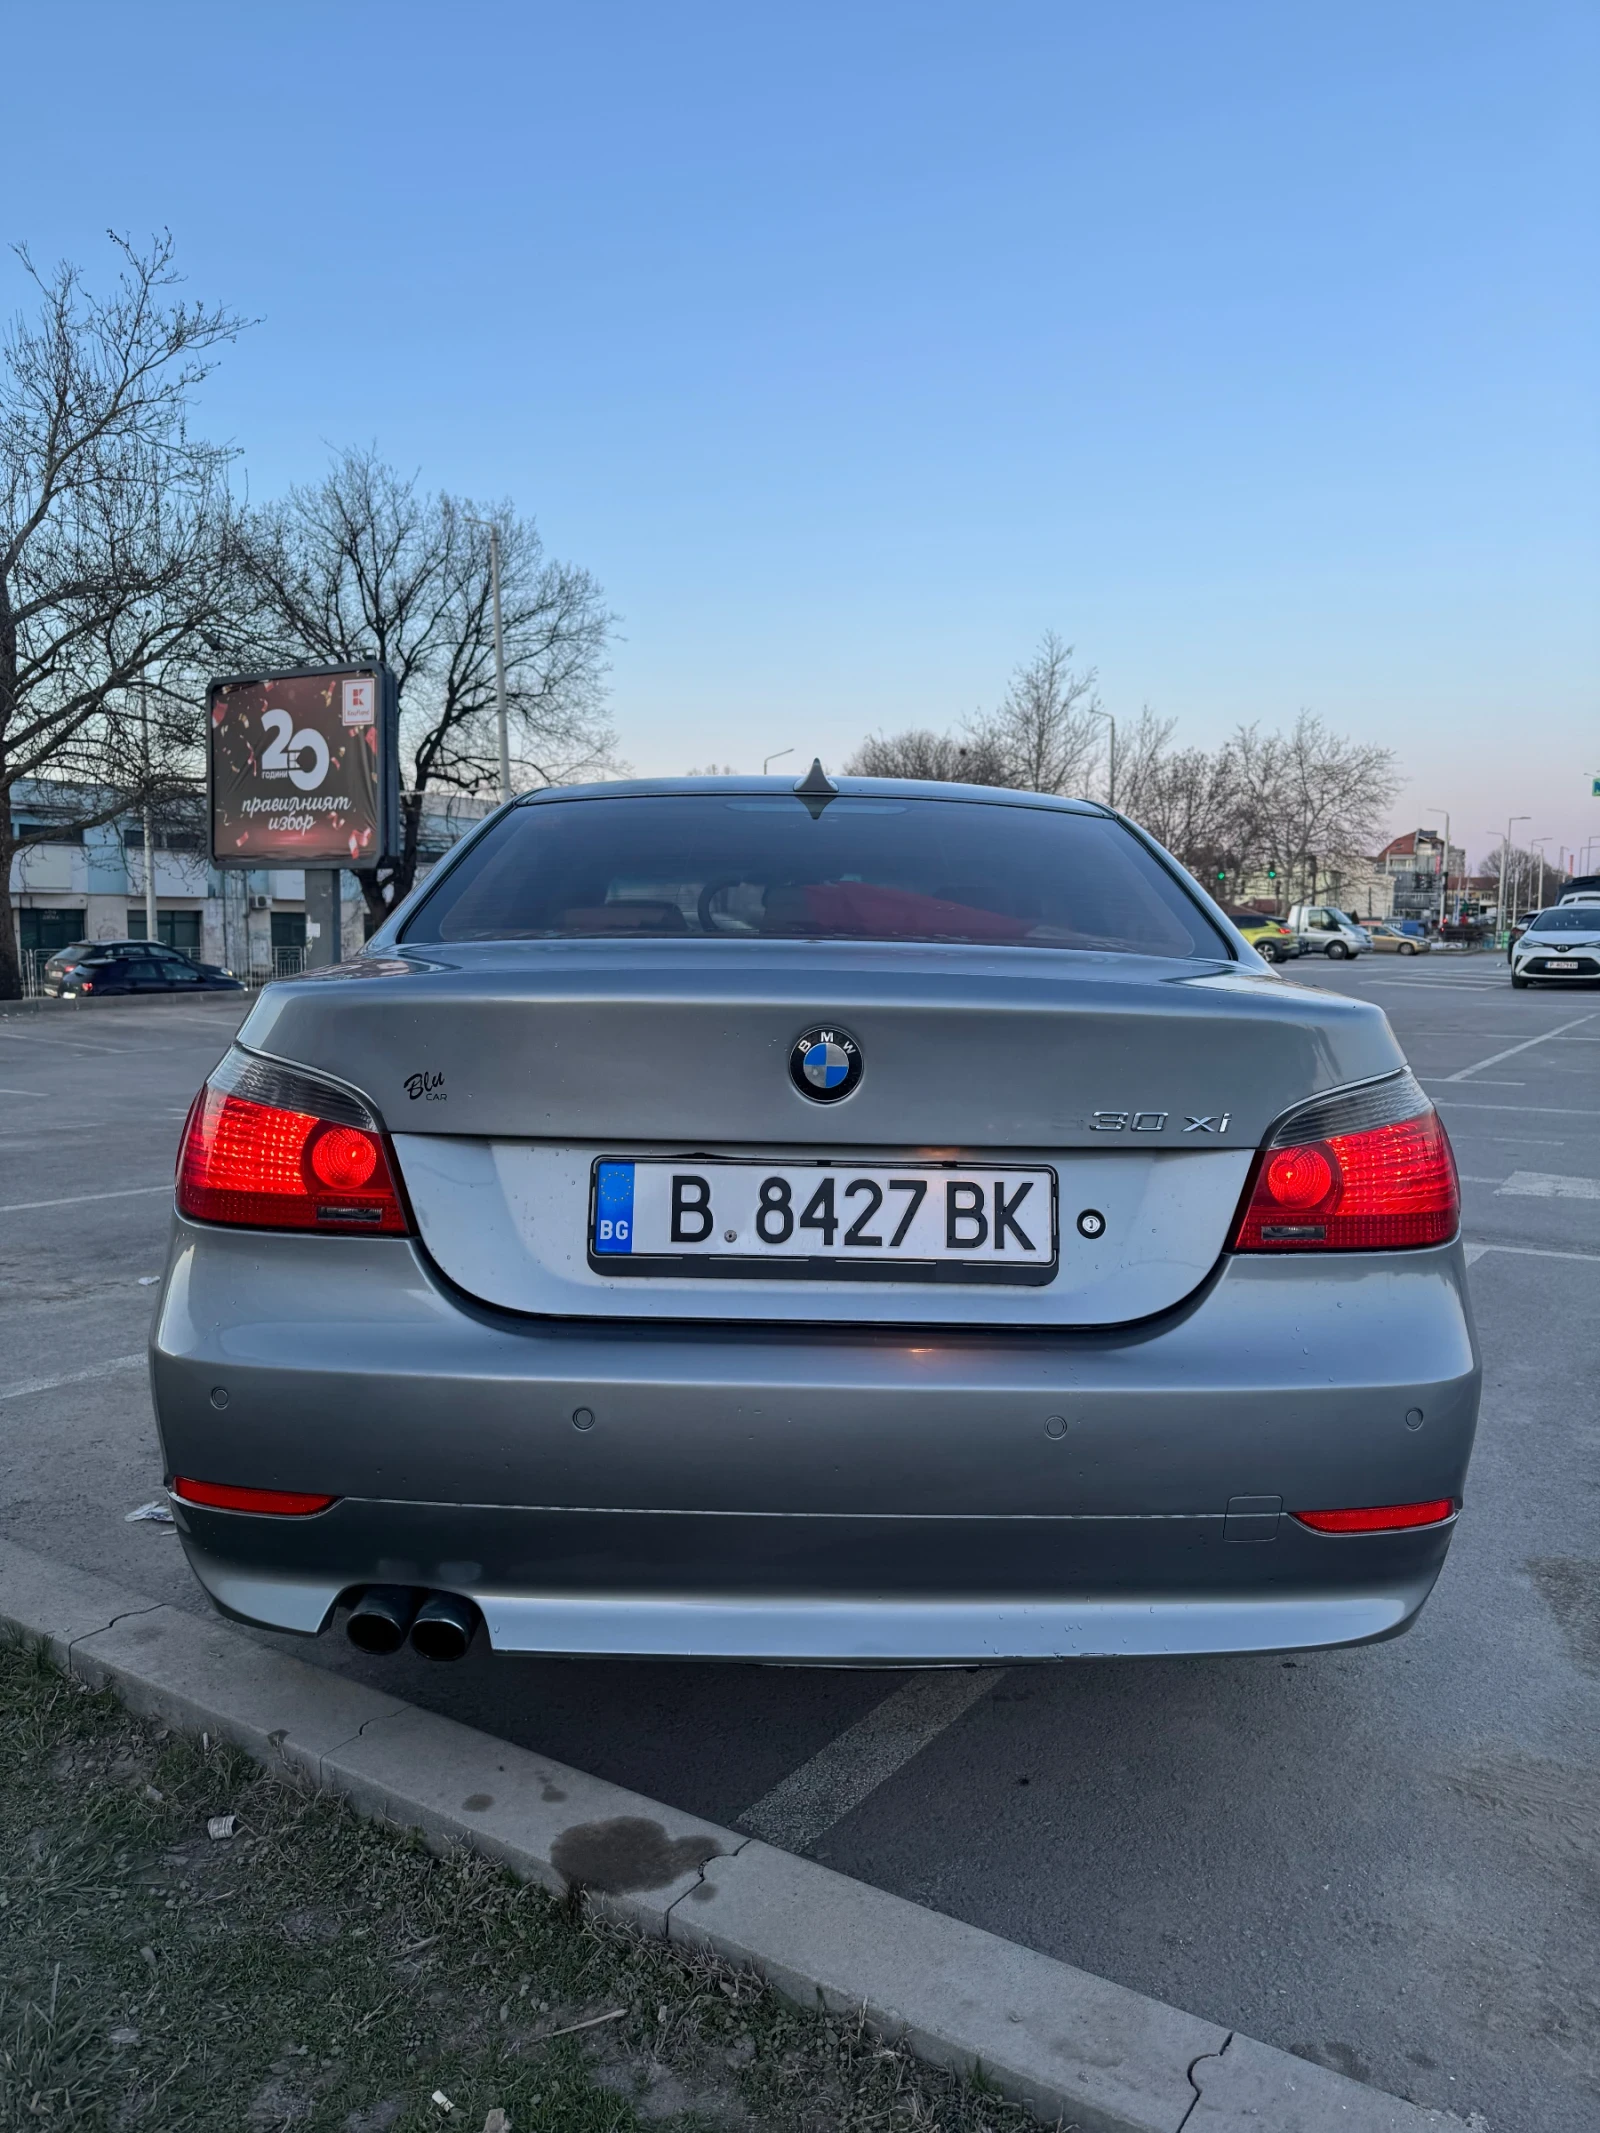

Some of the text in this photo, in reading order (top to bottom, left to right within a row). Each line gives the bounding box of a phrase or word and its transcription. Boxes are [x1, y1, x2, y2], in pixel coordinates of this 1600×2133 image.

[261, 709, 330, 791] 20
[242, 796, 352, 818] правилният
[268, 810, 316, 836] избор
[798, 1031, 856, 1053] BMW
[404, 1071, 445, 1100] Blu
[426, 1093, 447, 1101] CAR
[1090, 1111, 1233, 1133] 30 xi
[670, 1175, 1037, 1250] B 8427 BK
[600, 1219, 629, 1240] BG
